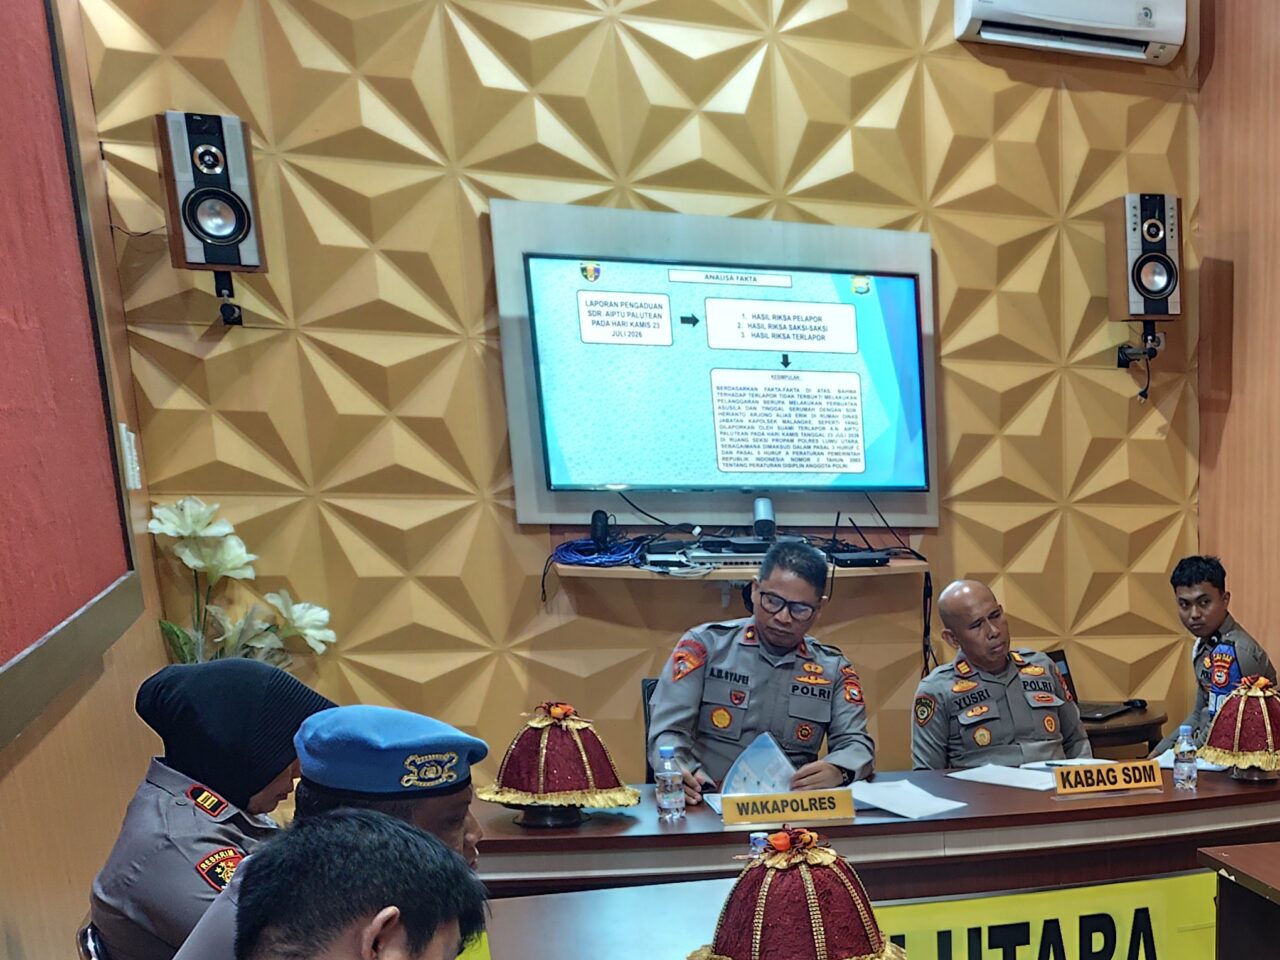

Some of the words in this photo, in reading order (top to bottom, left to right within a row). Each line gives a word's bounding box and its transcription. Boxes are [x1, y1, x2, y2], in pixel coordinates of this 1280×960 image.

[585, 300, 618, 308] LAPORAN
[789, 324, 828, 332] SAKSI-SAKSI
[792, 333, 825, 341] TERLAPOR
[792, 685, 831, 699] POLRI
[1023, 680, 1053, 692] POLRI
[954, 689, 991, 709] YUSRI
[1061, 768, 1117, 789] KABAG
[1123, 765, 1156, 784] SDM
[737, 796, 836, 816] WAKAPOLRES
[200, 849, 235, 870] RESKRIM
